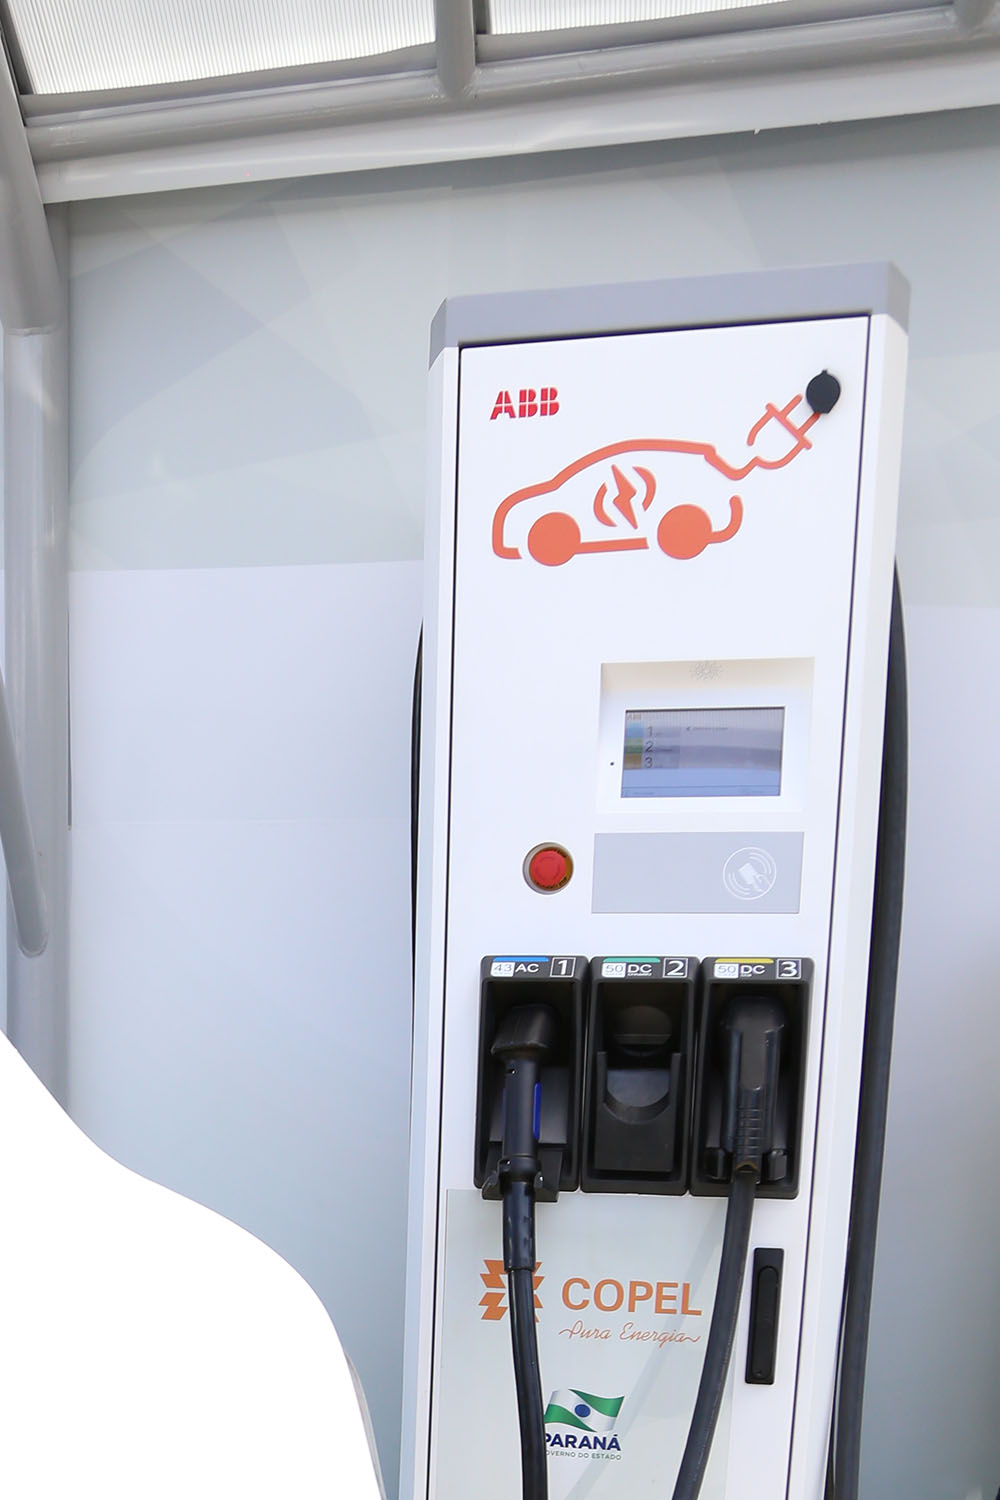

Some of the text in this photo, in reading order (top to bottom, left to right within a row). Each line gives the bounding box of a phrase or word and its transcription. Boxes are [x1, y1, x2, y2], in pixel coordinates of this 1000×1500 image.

[490, 387, 560, 420] ABB
[515, 962, 540, 973] AC
[557, 959, 569, 975] 1
[627, 964, 653, 974] DC
[667, 960, 685, 976] 2
[740, 964, 766, 975] DC
[780, 961, 798, 977] 3
[562, 1277, 702, 1316] COPEL
[559, 1320, 702, 1348] Pura Energia
[545, 1450, 576, 1458] OVERNO
[591, 1453, 622, 1461] ESTADO
